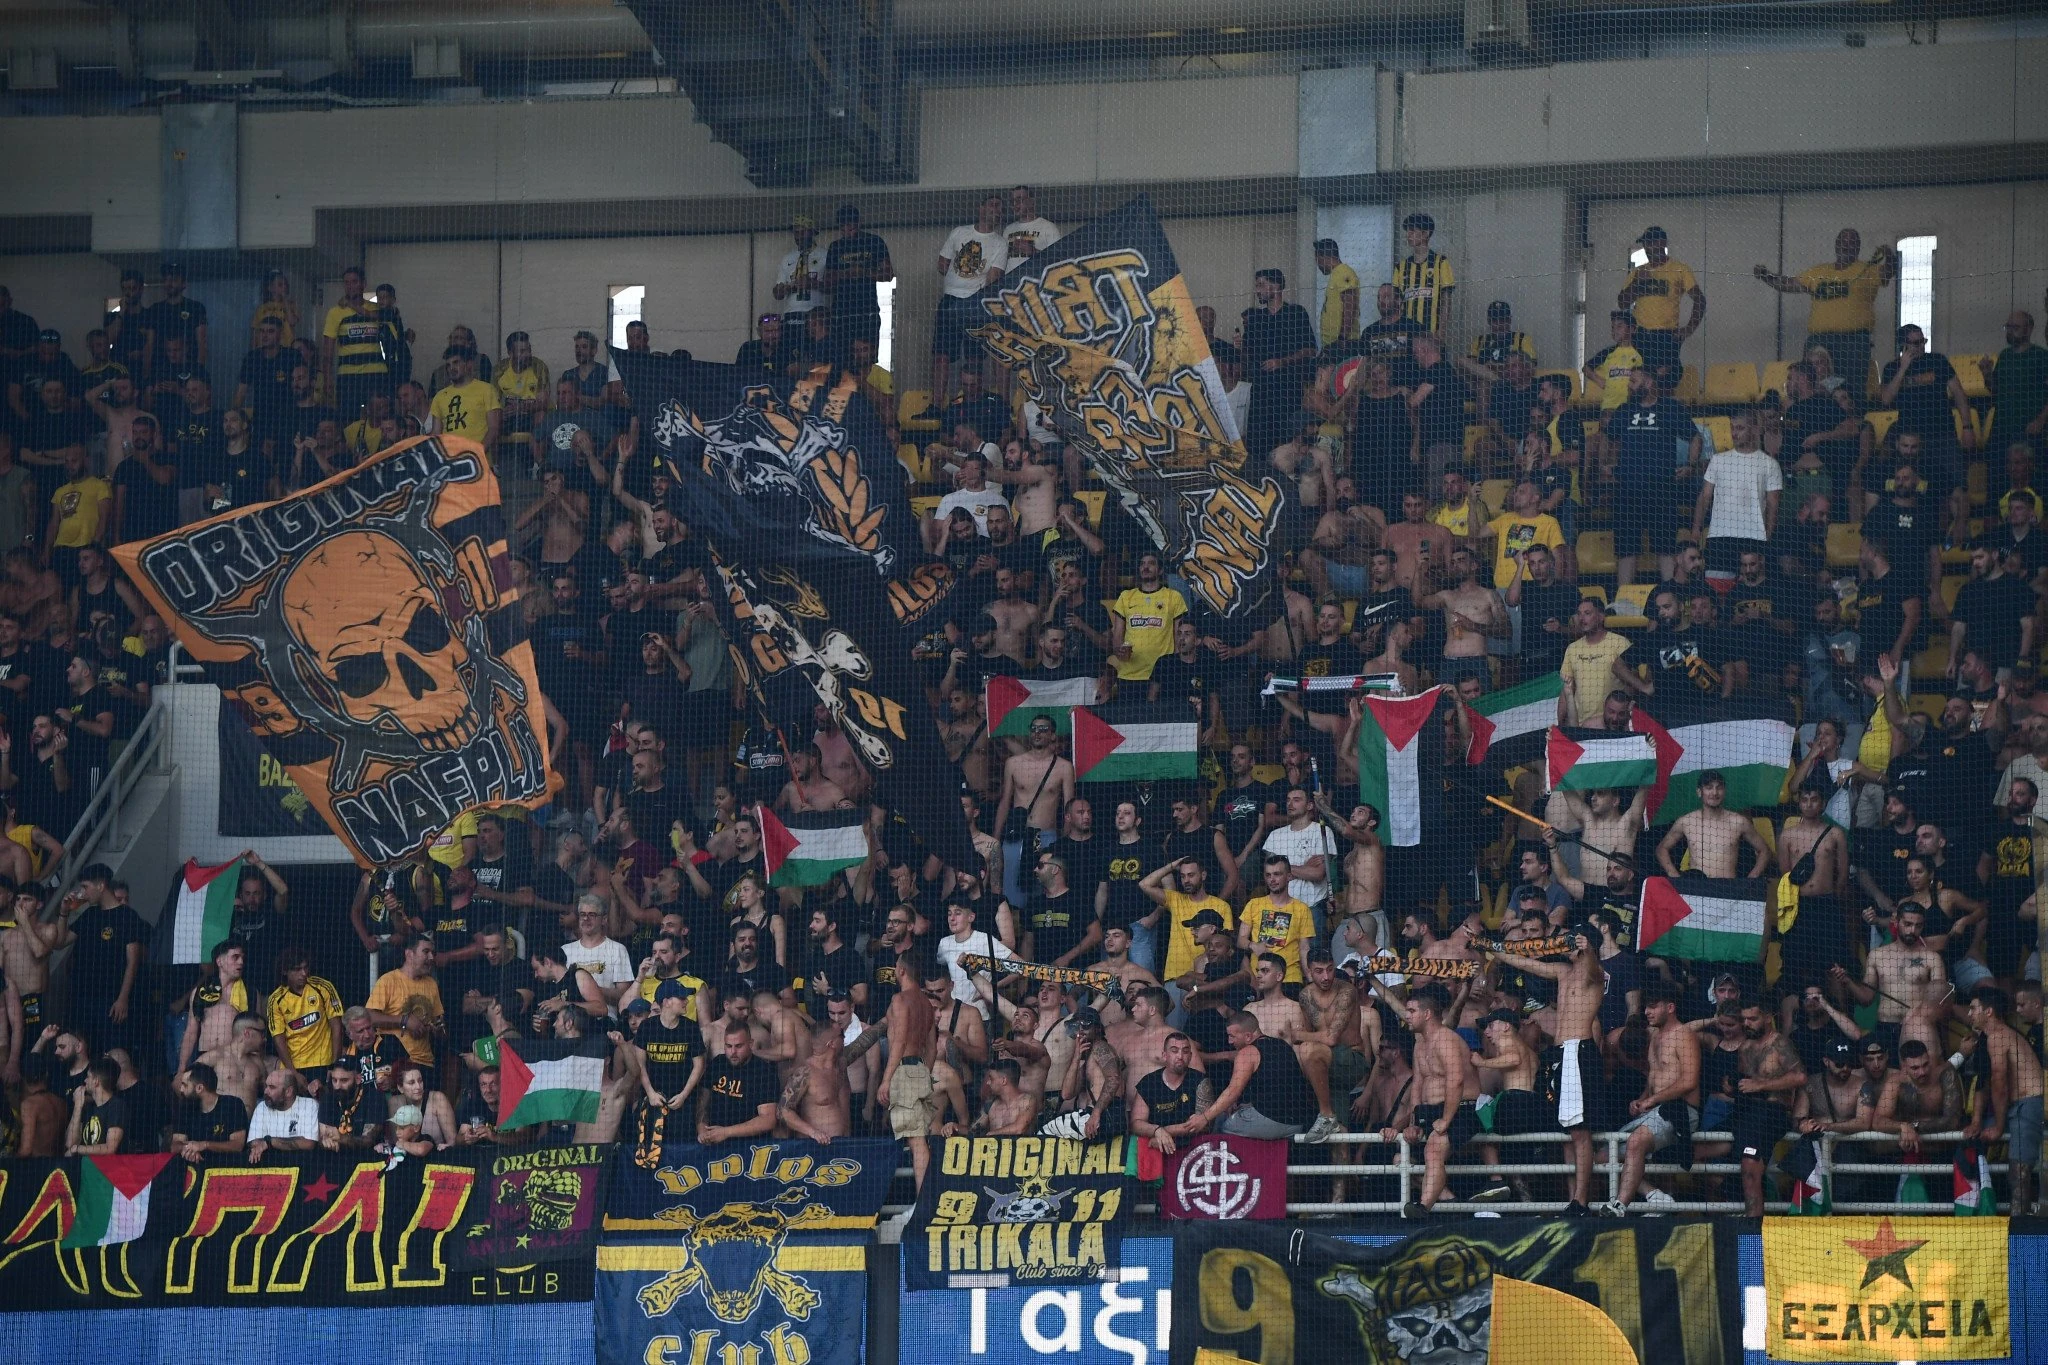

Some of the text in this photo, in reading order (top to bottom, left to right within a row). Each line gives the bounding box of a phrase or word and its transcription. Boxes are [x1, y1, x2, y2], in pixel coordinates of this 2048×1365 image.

[303, 1014, 317, 1026] TIM
[493, 1145, 603, 1176] ORIGINAL
[942, 1135, 1126, 1177] ORIGINAL
[931, 1187, 1122, 1225] 9 11
[925, 1221, 1106, 1272] TRIKALA
[472, 1273, 559, 1296] CLUB
[1016, 1263, 1048, 1280] Club
[1050, 1265, 1082, 1279] since
[1782, 1300, 1995, 1341] ΕΞΑΡΧΕΙΑ
